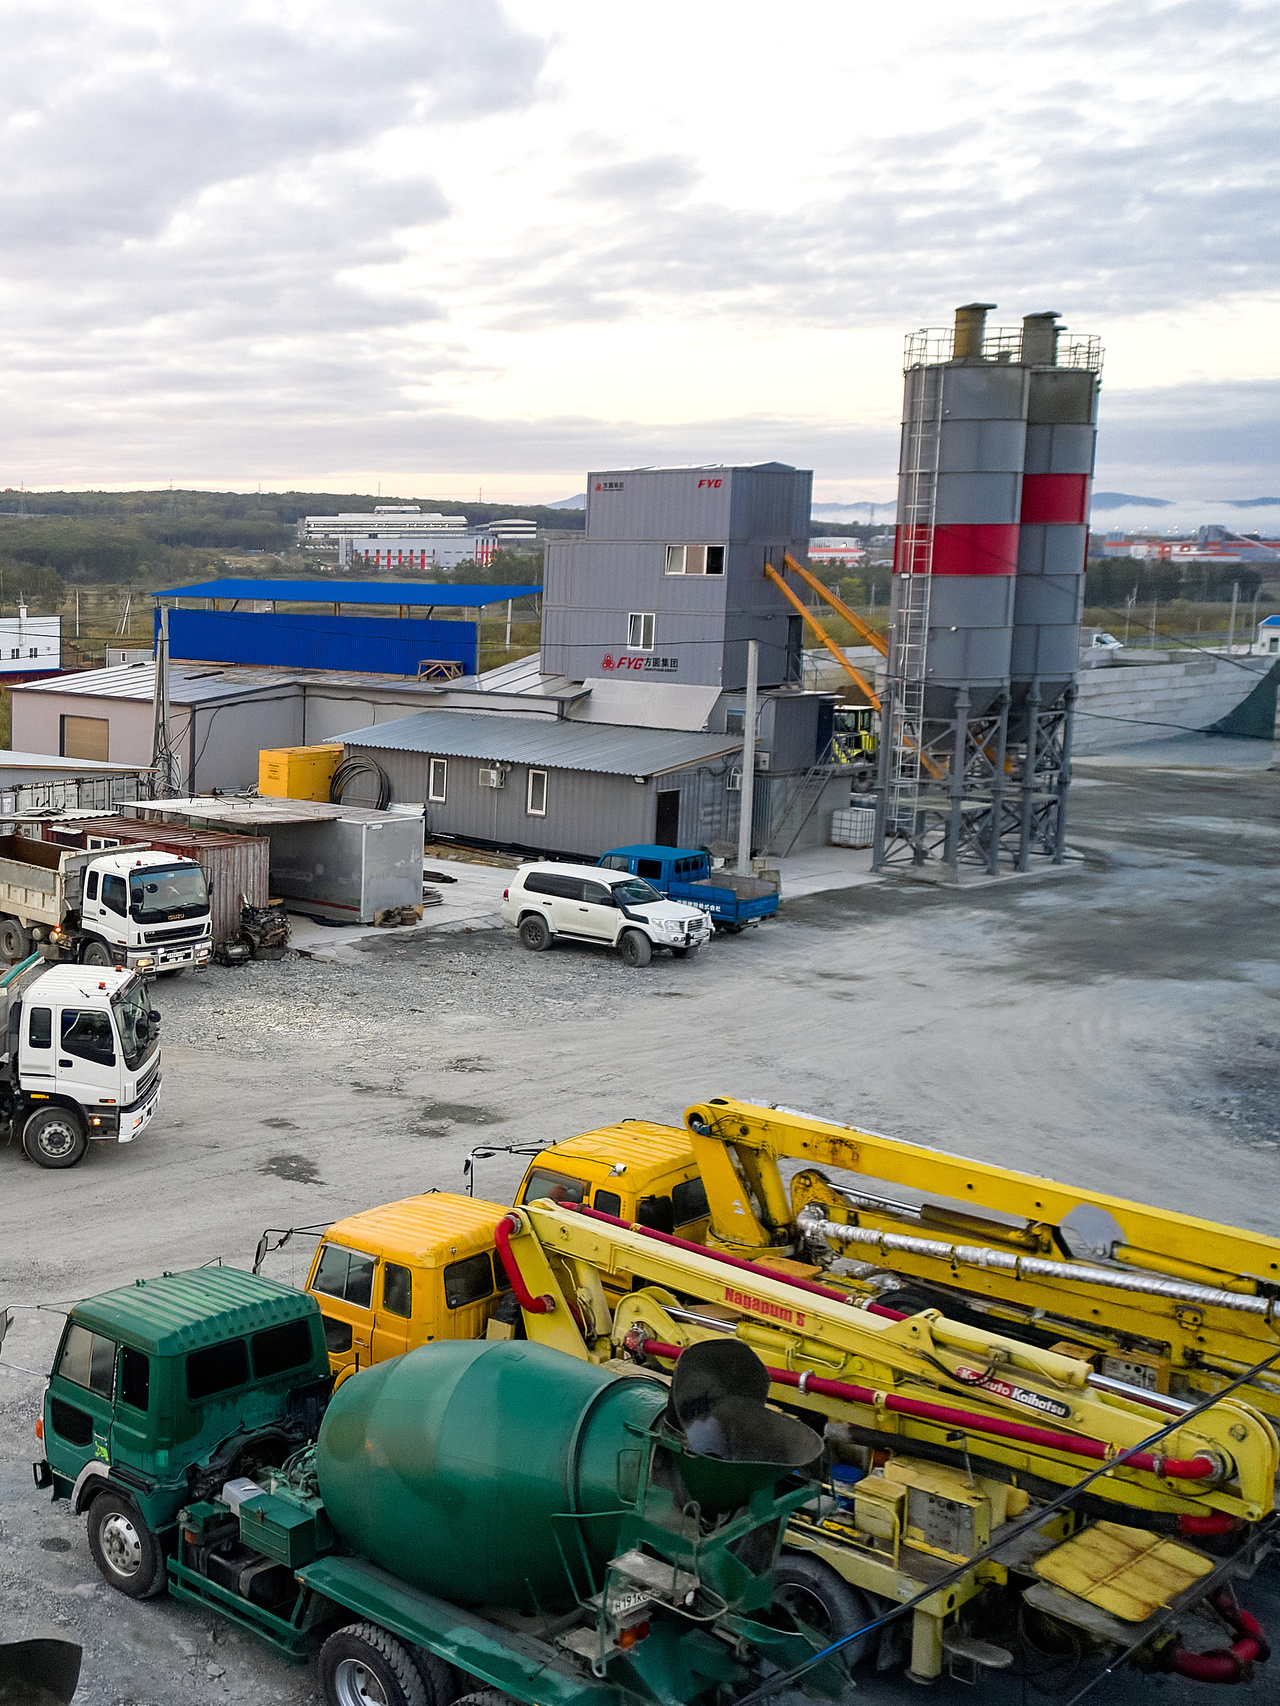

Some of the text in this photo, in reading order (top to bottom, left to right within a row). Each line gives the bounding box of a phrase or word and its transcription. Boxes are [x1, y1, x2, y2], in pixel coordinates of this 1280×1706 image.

[697, 479, 722, 489] FYG
[616, 656, 644, 670] FYG
[725, 1287, 806, 1327] Nagapum S
[1011, 1387, 1066, 1416] Kaihatsu
